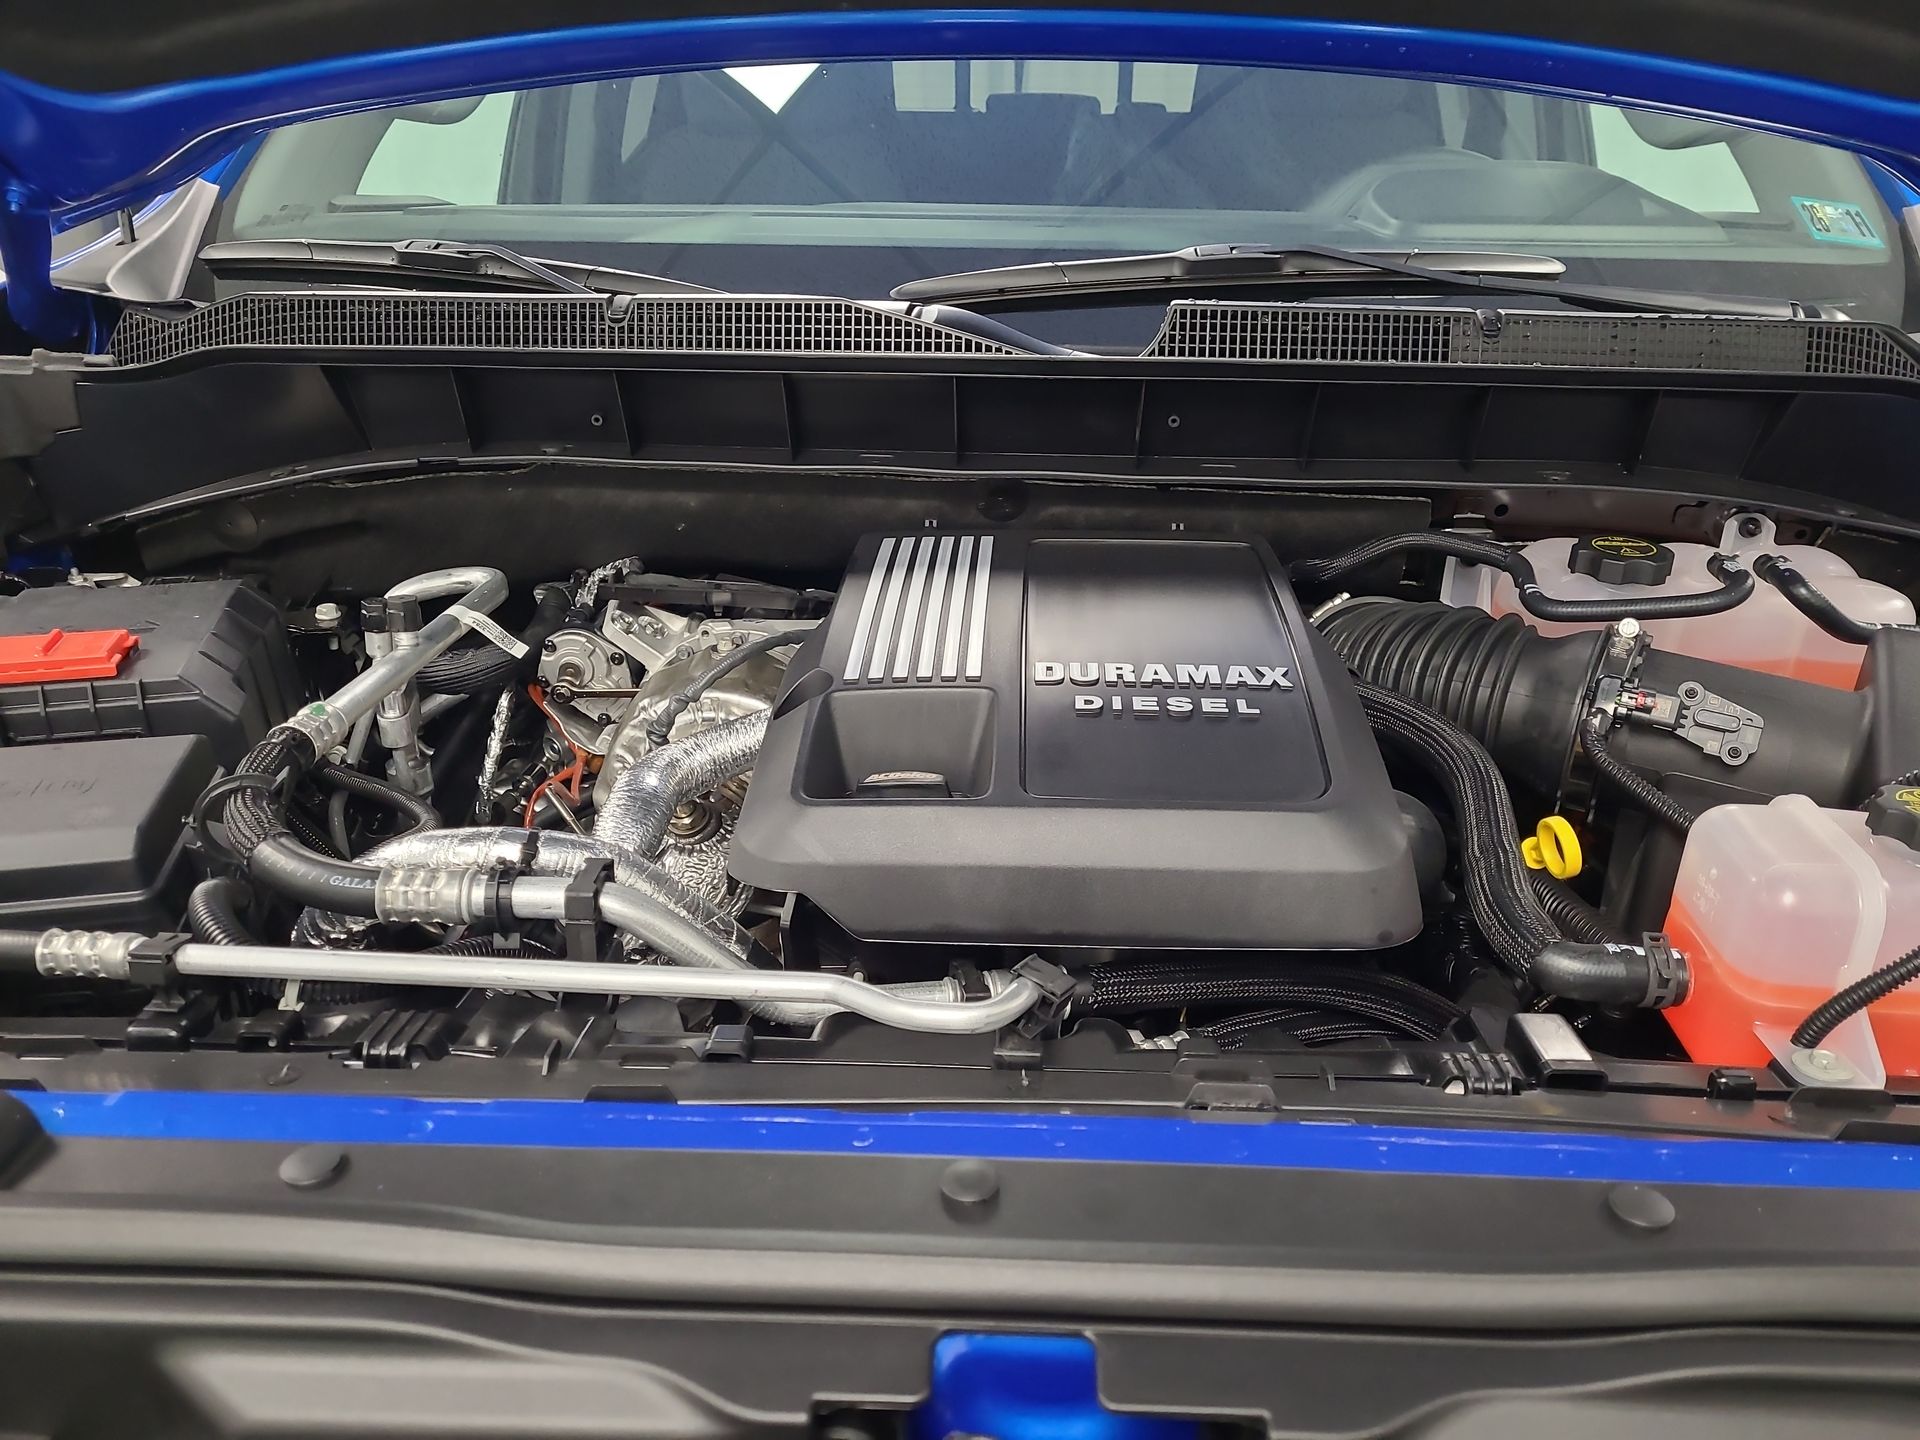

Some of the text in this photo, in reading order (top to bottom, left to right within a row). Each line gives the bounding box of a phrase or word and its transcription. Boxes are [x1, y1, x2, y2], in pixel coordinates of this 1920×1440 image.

[1845, 209, 1876, 238] 11
[1034, 661, 1295, 689] DURAMAX
[1074, 695, 1262, 715] DIESEL
[329, 875, 378, 889] GALA
